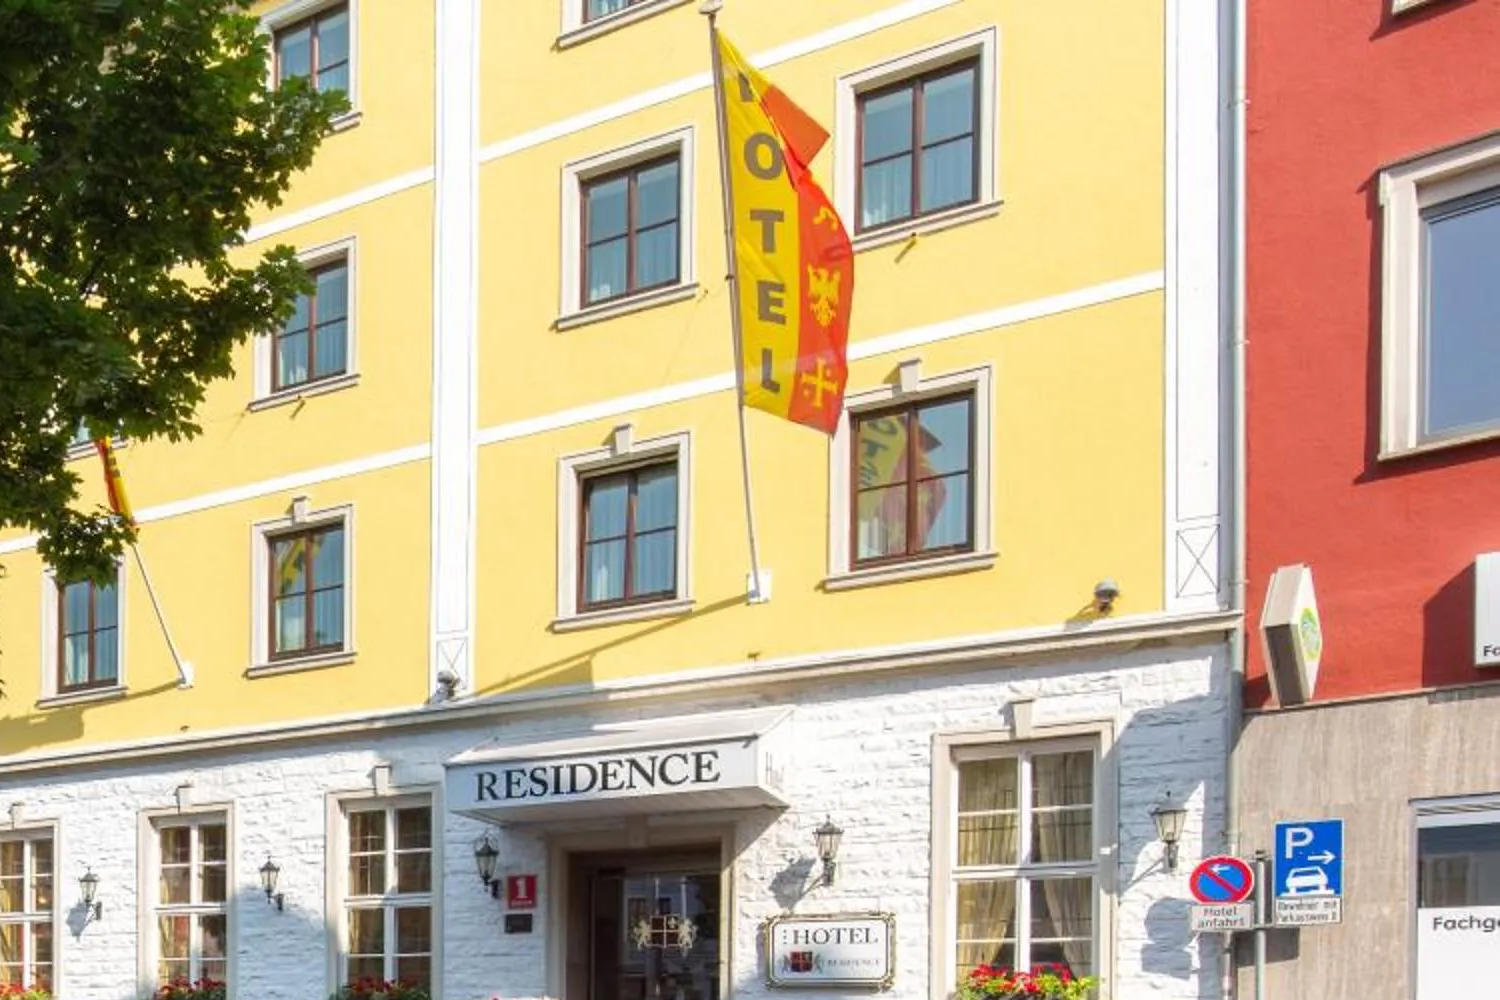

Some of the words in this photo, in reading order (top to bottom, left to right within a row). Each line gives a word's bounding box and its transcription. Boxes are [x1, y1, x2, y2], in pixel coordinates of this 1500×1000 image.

[476, 750, 721, 801] RESIDENCE
[1285, 827, 1314, 858] P
[1203, 906, 1238, 917] Hotel
[1432, 915, 1500, 933] Fachg
[792, 927, 880, 945] HOTEL
